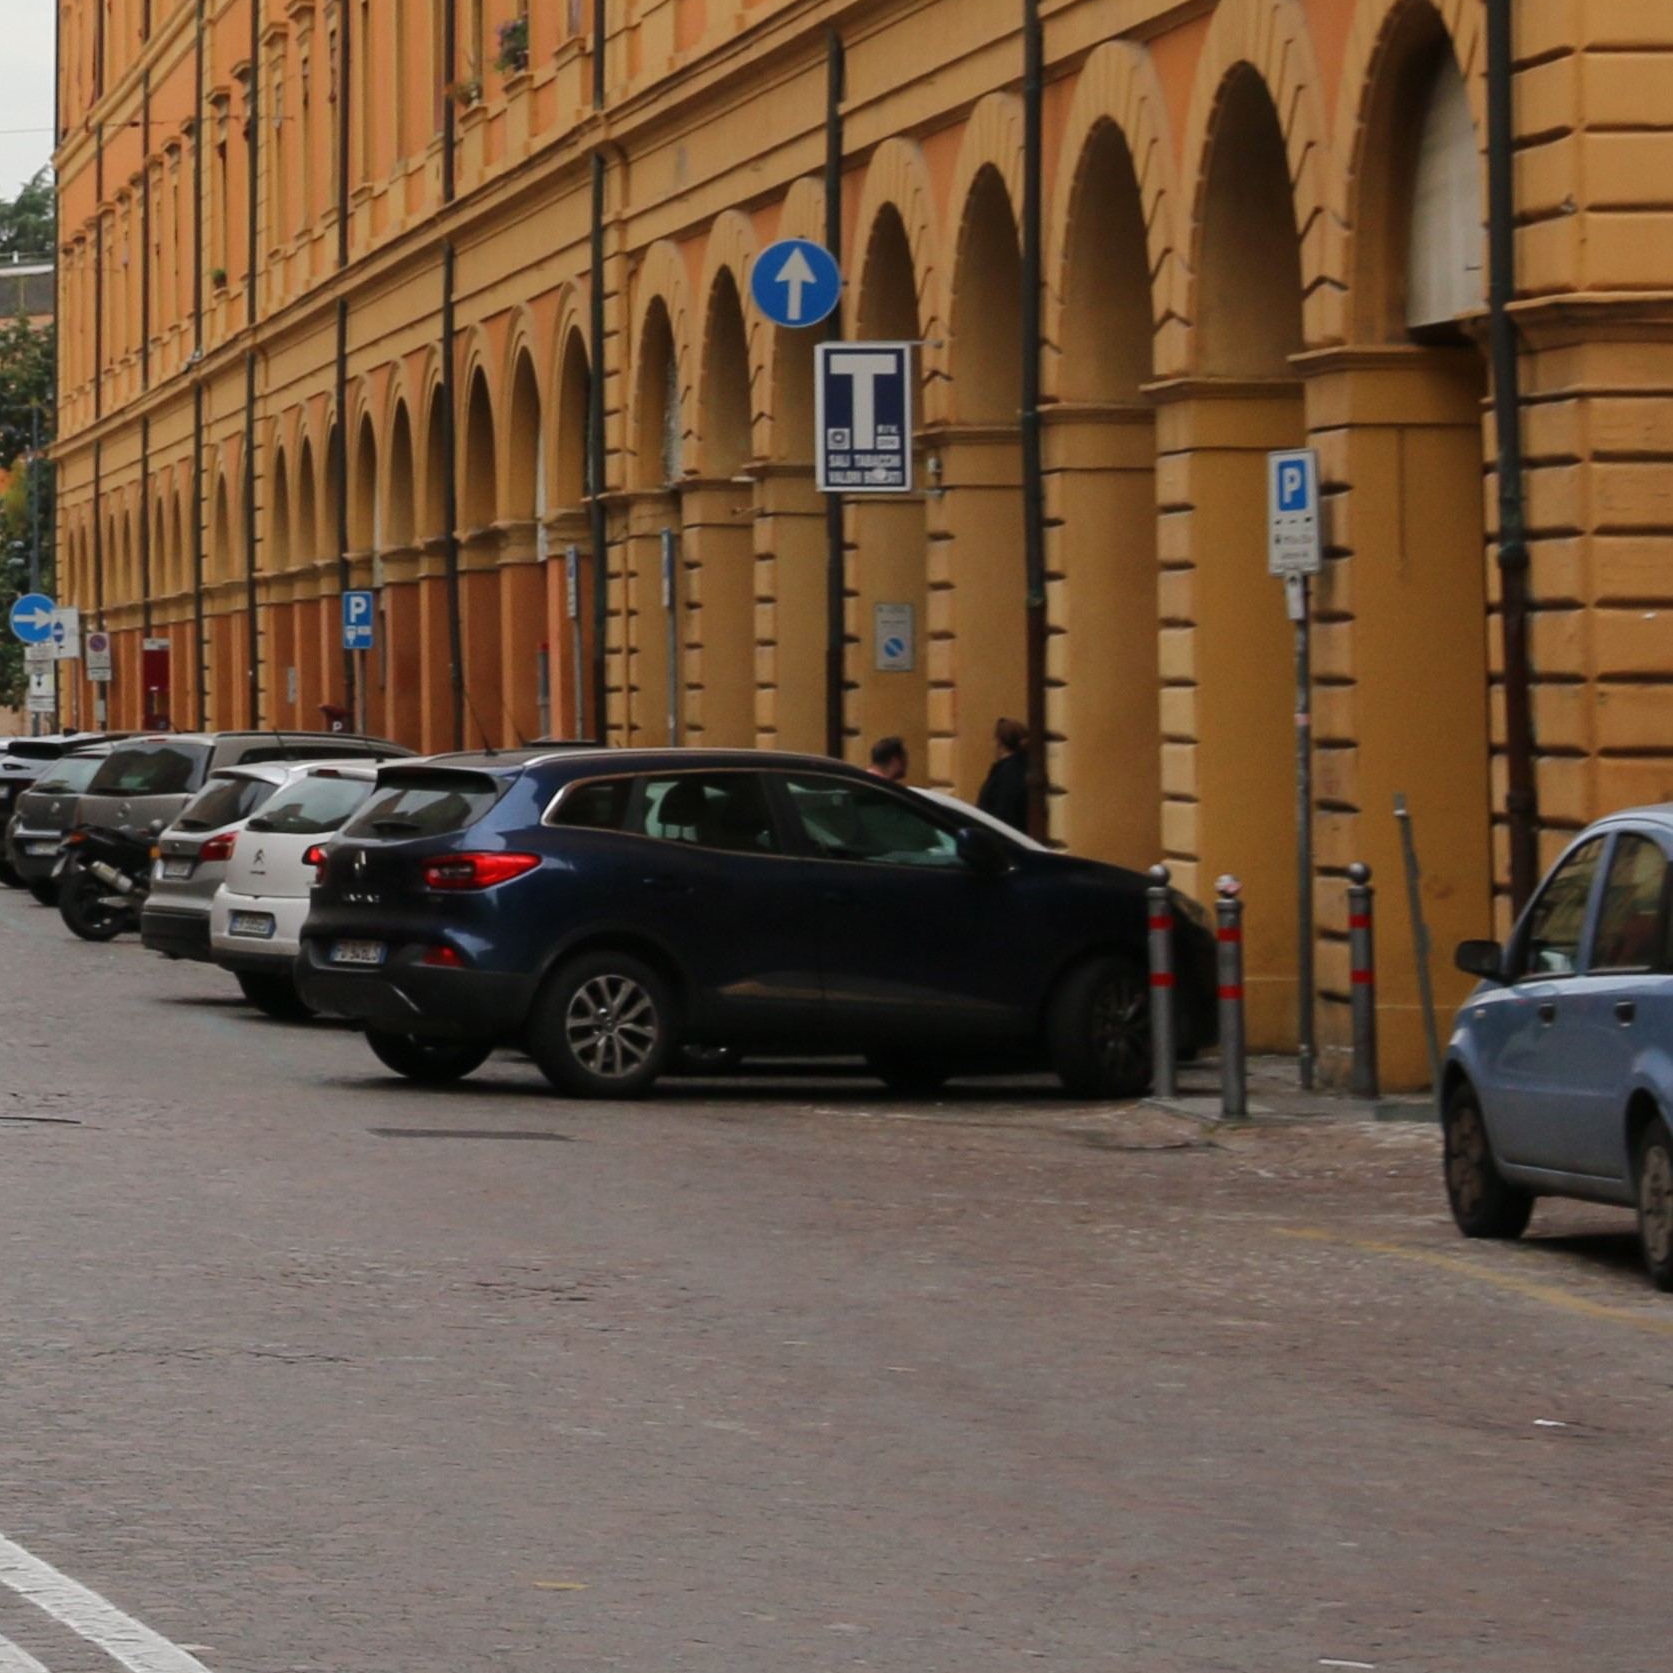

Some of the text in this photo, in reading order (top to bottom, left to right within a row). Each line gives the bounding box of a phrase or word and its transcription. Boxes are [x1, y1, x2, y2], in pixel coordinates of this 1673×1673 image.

[830, 354, 897, 449] T
[1282, 467, 1302, 503] P
[349, 595, 367, 623] P
